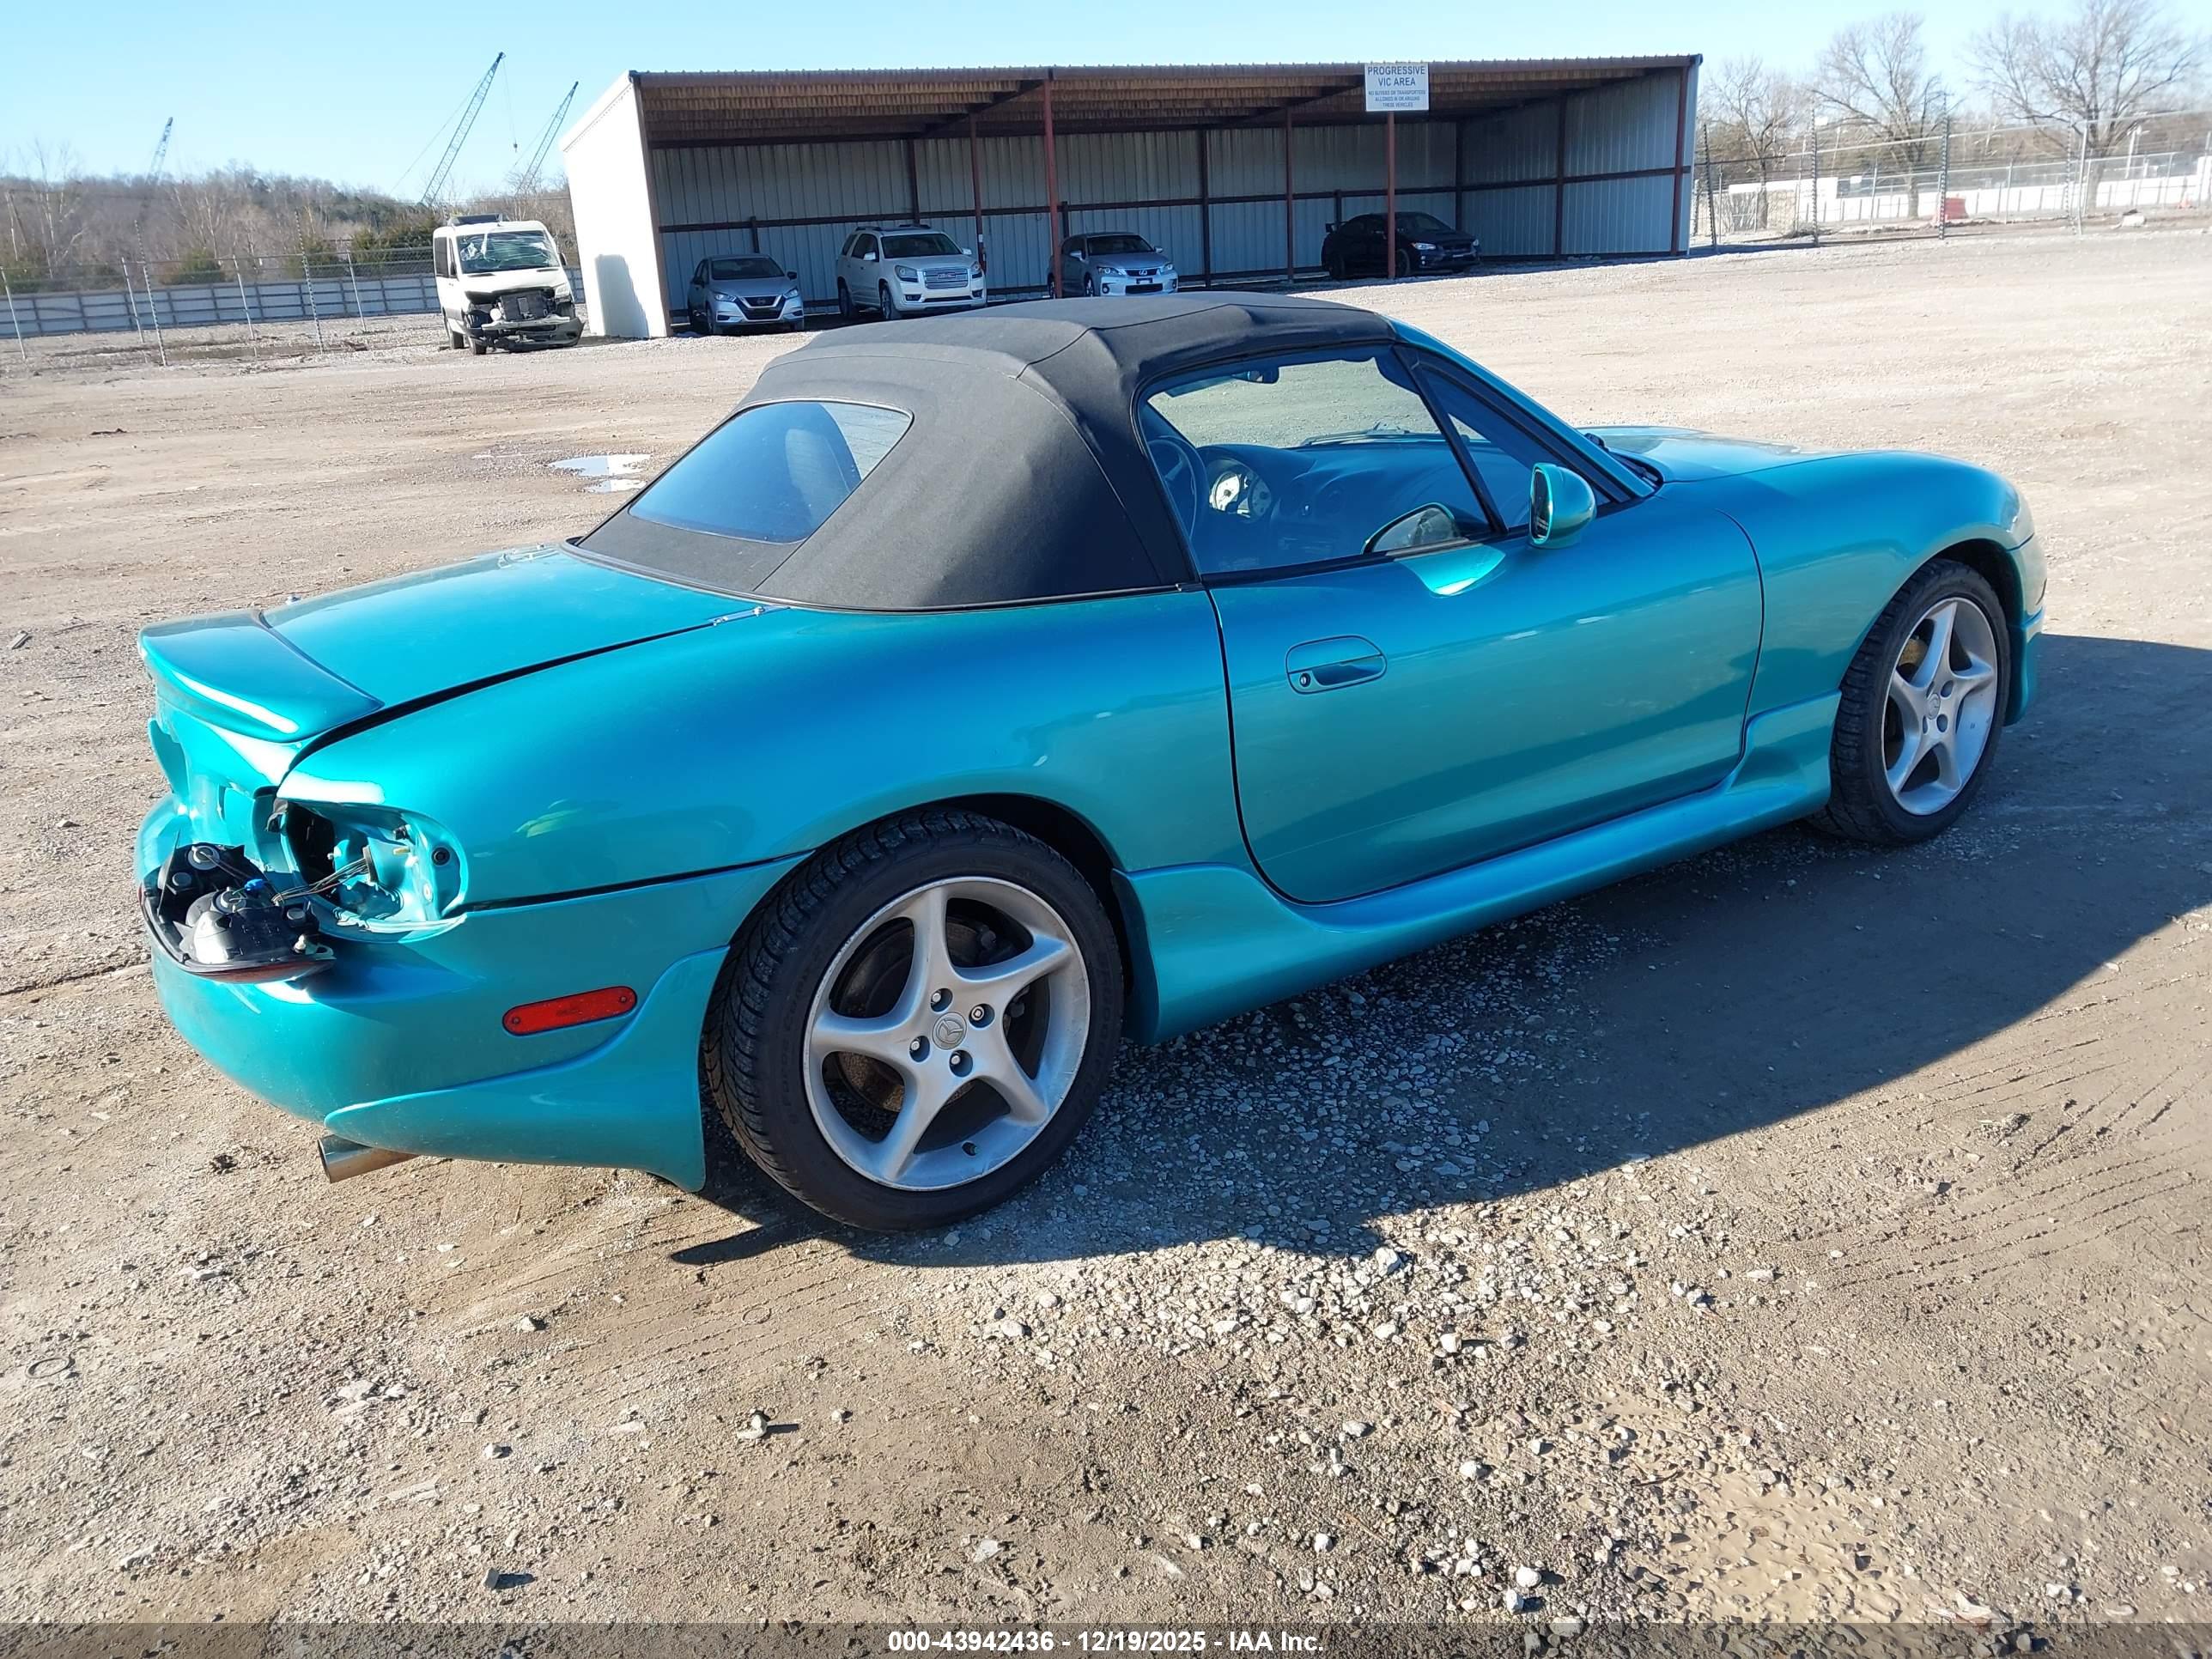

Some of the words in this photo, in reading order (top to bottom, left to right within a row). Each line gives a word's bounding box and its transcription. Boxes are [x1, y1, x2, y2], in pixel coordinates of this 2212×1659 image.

[1368, 65, 1425, 76] PROGRESSIVE
[1378, 77, 1391, 86] VIC
[1394, 76, 1416, 86] AREA
